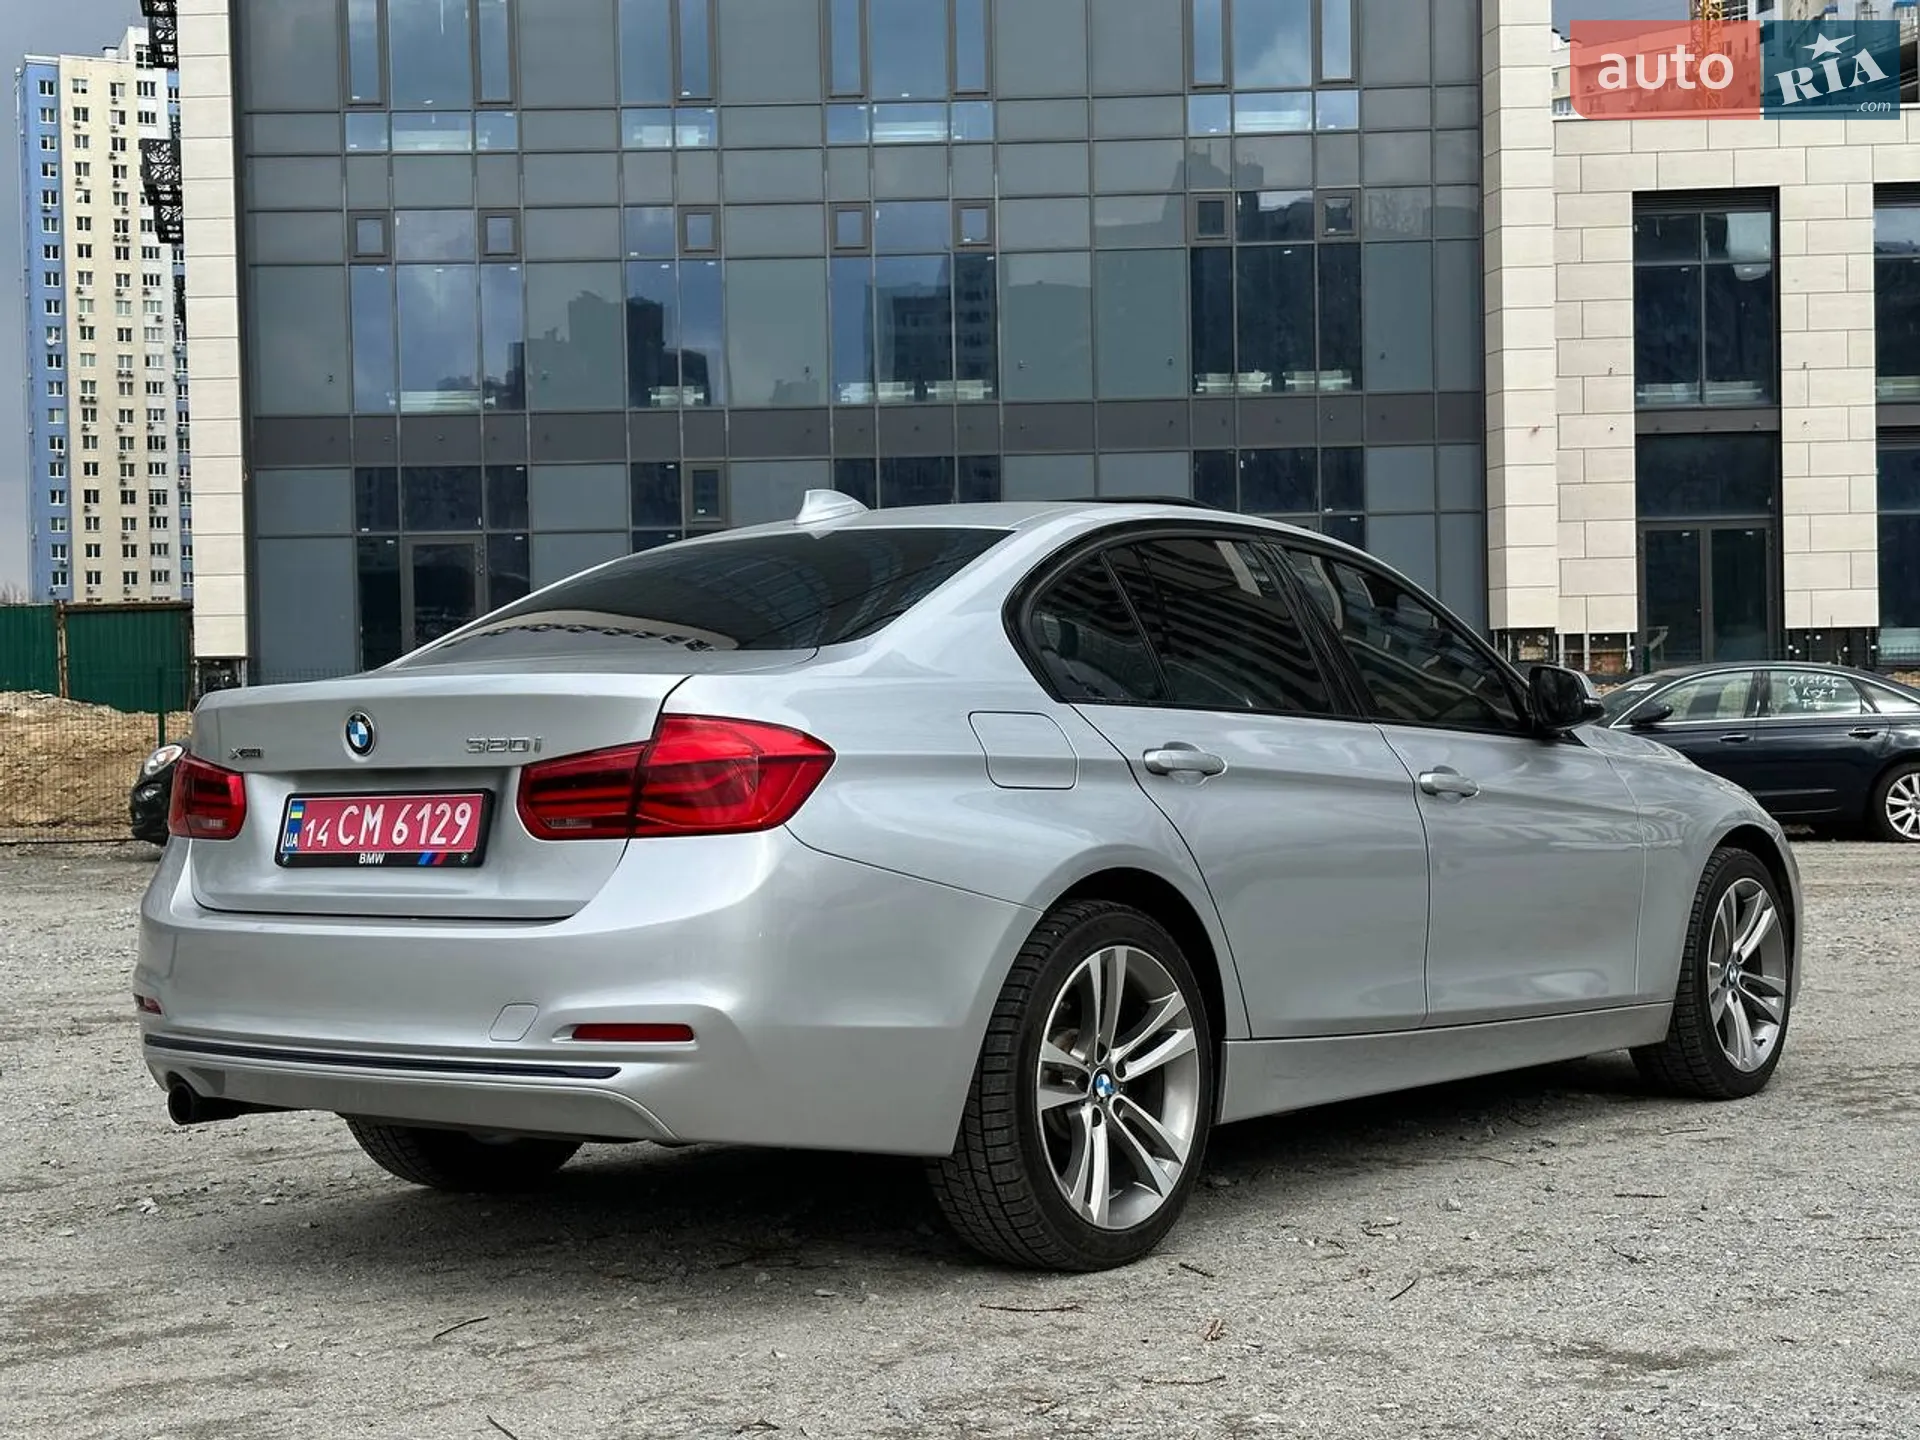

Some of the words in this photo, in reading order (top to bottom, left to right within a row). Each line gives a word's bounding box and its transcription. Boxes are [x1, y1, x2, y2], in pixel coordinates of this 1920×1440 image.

[466, 736, 542, 754] 320i
[305, 818, 331, 847] 14
[337, 804, 385, 846] CM
[391, 802, 472, 846] 6129
[285, 833, 299, 848] UA
[358, 853, 386, 865] BMW
